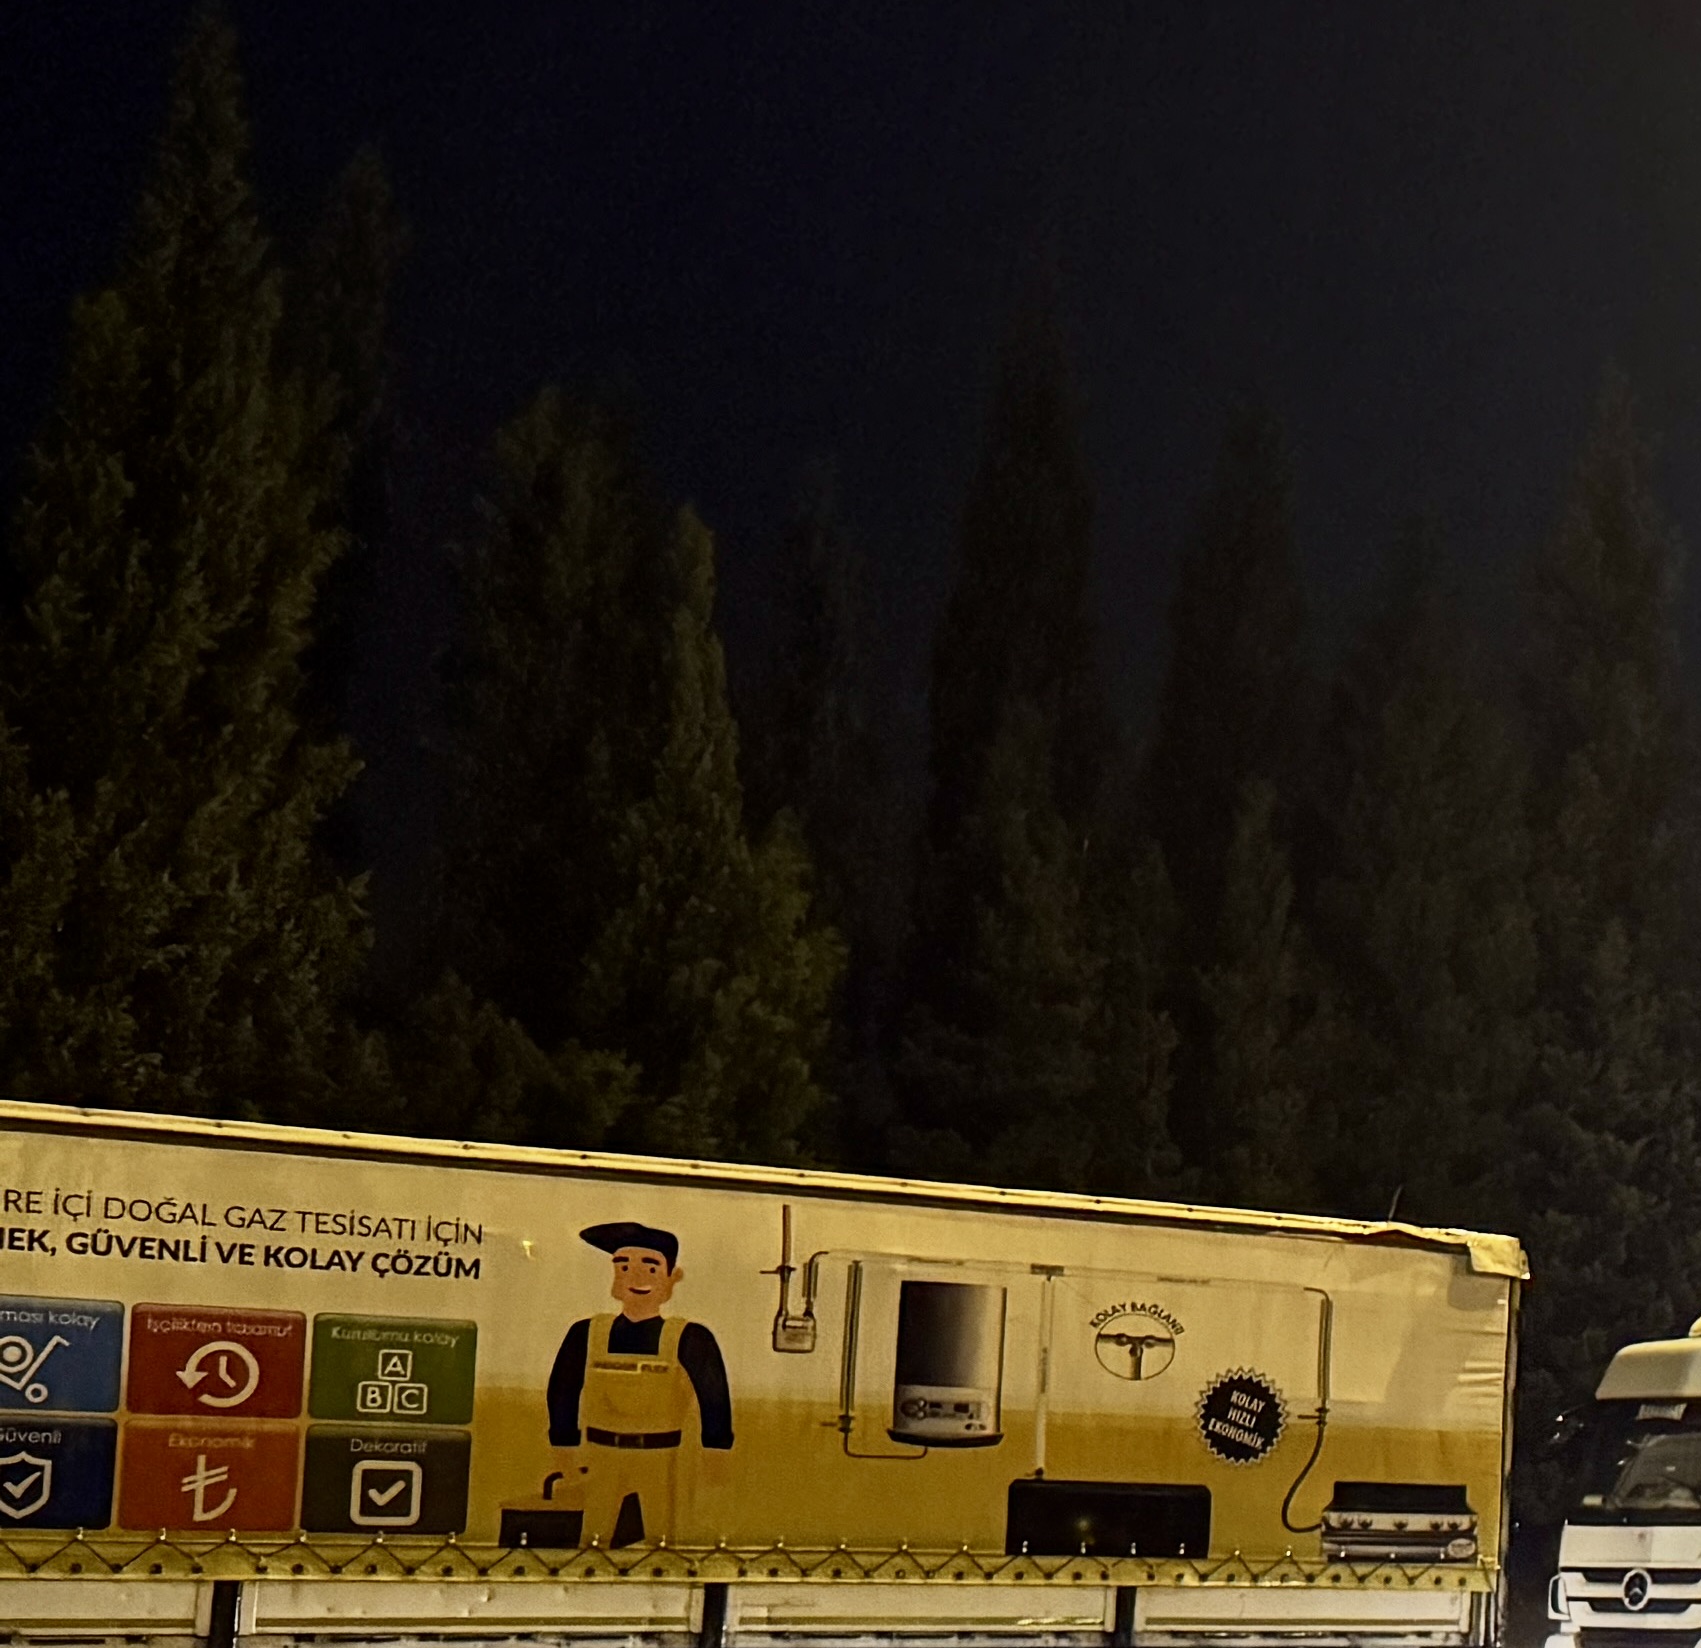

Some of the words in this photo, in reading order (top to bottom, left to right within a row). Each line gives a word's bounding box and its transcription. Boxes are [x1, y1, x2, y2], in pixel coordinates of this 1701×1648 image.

[3, 1188, 43, 1214] RE
[53, 1187, 92, 1222] İÇİ
[103, 1196, 217, 1226] DOĞAL
[224, 1206, 287, 1232] GAZ
[294, 1209, 416, 1241] TESİSATI
[426, 1214, 483, 1246] İÇİN
[0, 1227, 56, 1257] EK,
[65, 1228, 207, 1263] GÜVENLİ
[215, 1241, 255, 1266] VE
[263, 1245, 365, 1272] KOLAY
[371, 1249, 481, 1279] ÇÖZÜM
[48, 1310, 100, 1332] kolay
[384, 1355, 406, 1375] A
[366, 1387, 382, 1407] B
[401, 1389, 420, 1409] C
[1230, 1390, 1266, 1413] KOLAY
[1227, 1406, 1257, 1429] HIZLI
[1208, 1417, 1265, 1450] EKONOMİK
